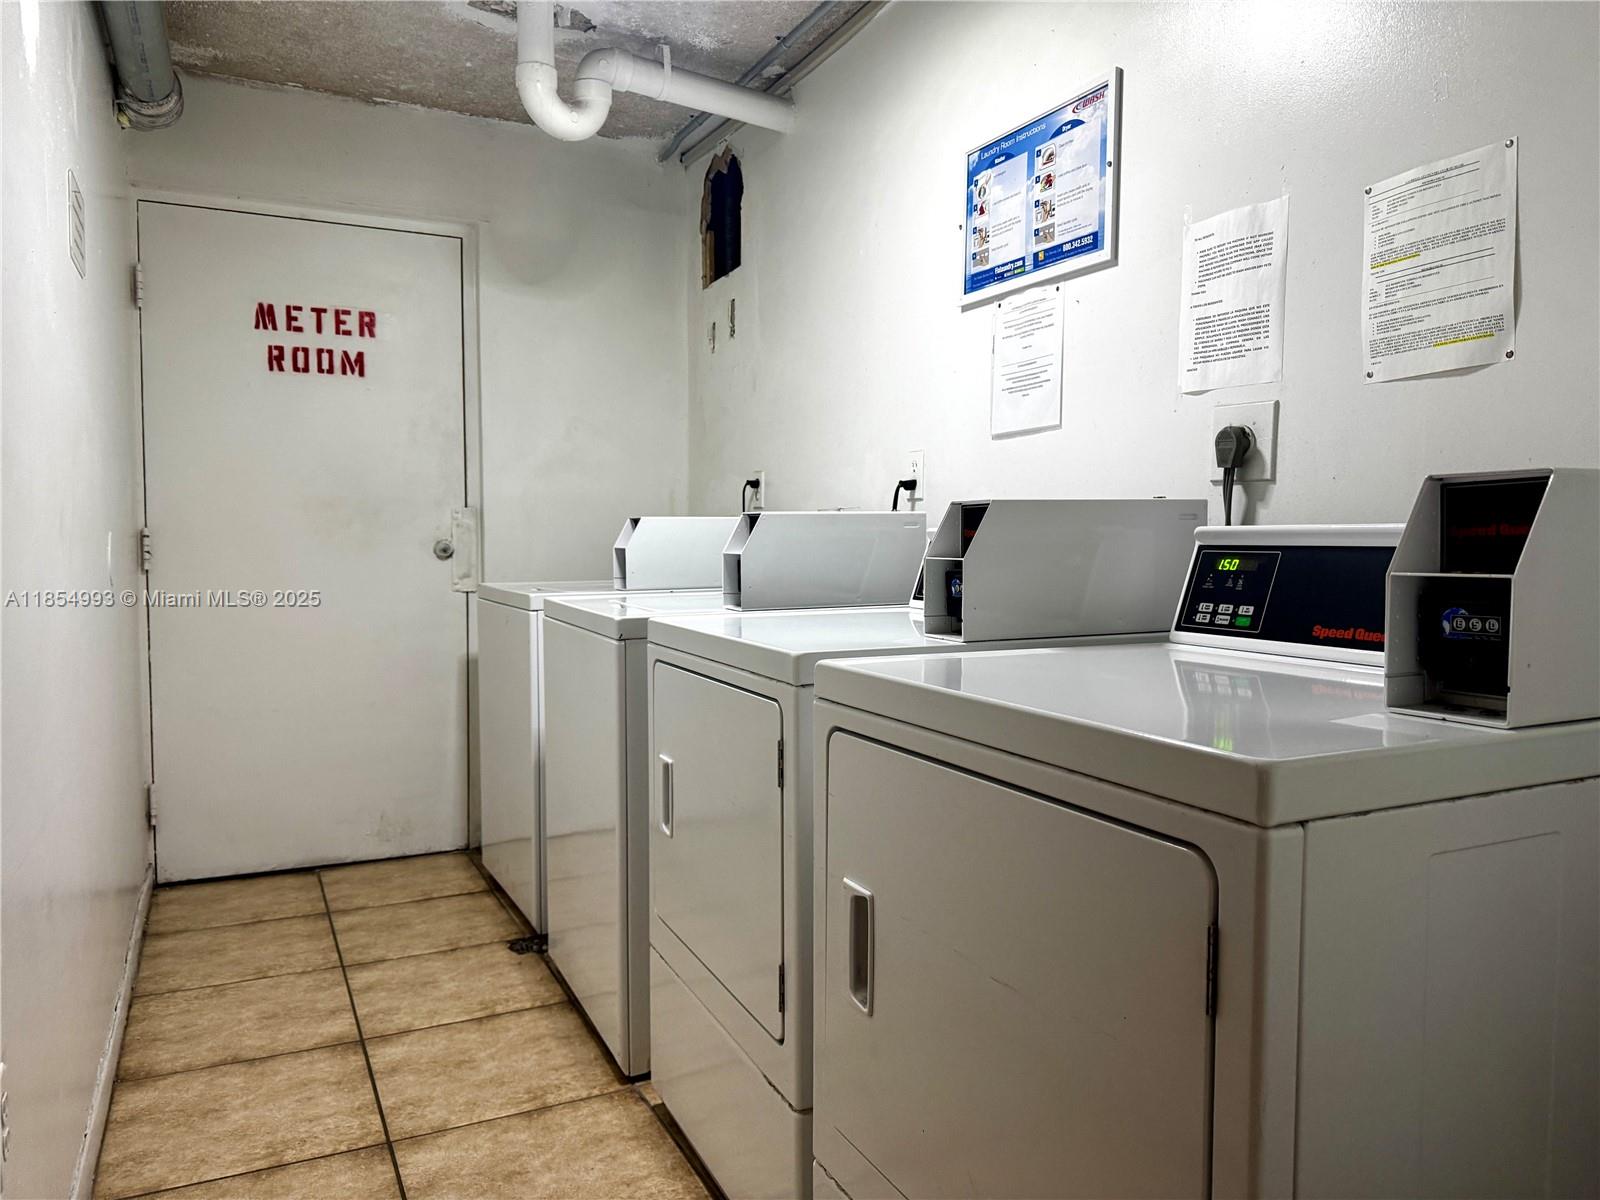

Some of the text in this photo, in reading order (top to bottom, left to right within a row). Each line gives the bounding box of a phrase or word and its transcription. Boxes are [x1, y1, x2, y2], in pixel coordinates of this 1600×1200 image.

[1082, 90, 1105, 108] WASH
[981, 123, 1047, 160] Laundry Room Instructions
[254, 302, 376, 338] METER
[268, 344, 365, 377] ROOM
[1312, 624, 1386, 642] Speed Que
